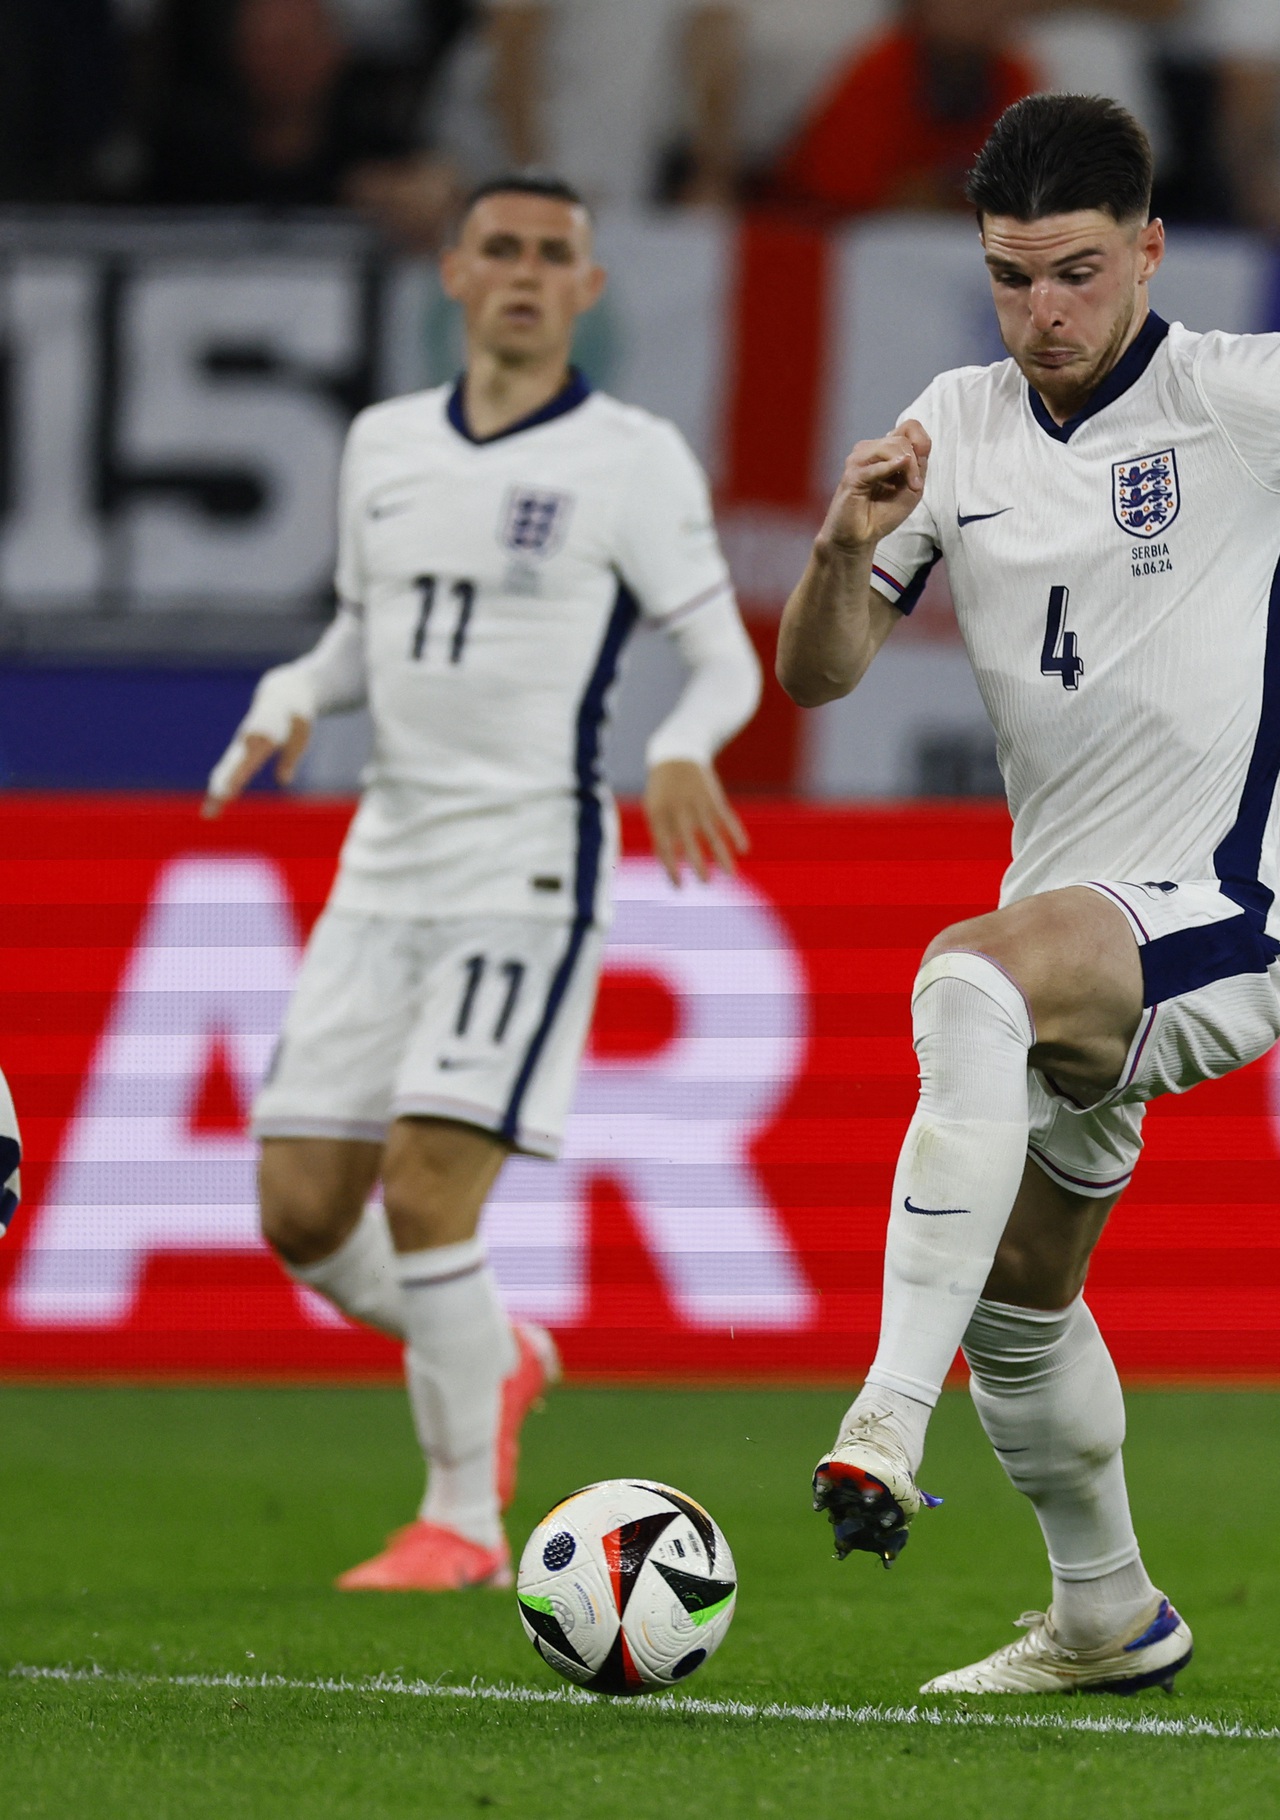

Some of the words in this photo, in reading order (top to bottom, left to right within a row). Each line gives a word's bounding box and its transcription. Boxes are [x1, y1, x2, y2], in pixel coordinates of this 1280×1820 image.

[1131, 543, 1170, 561] SERBIA
[1131, 558, 1173, 577] 16.06.24
[410, 573, 475, 664] 11
[1040, 585, 1084, 691] 4
[454, 952, 526, 1046] 11
[5, 850, 820, 1330] AR
